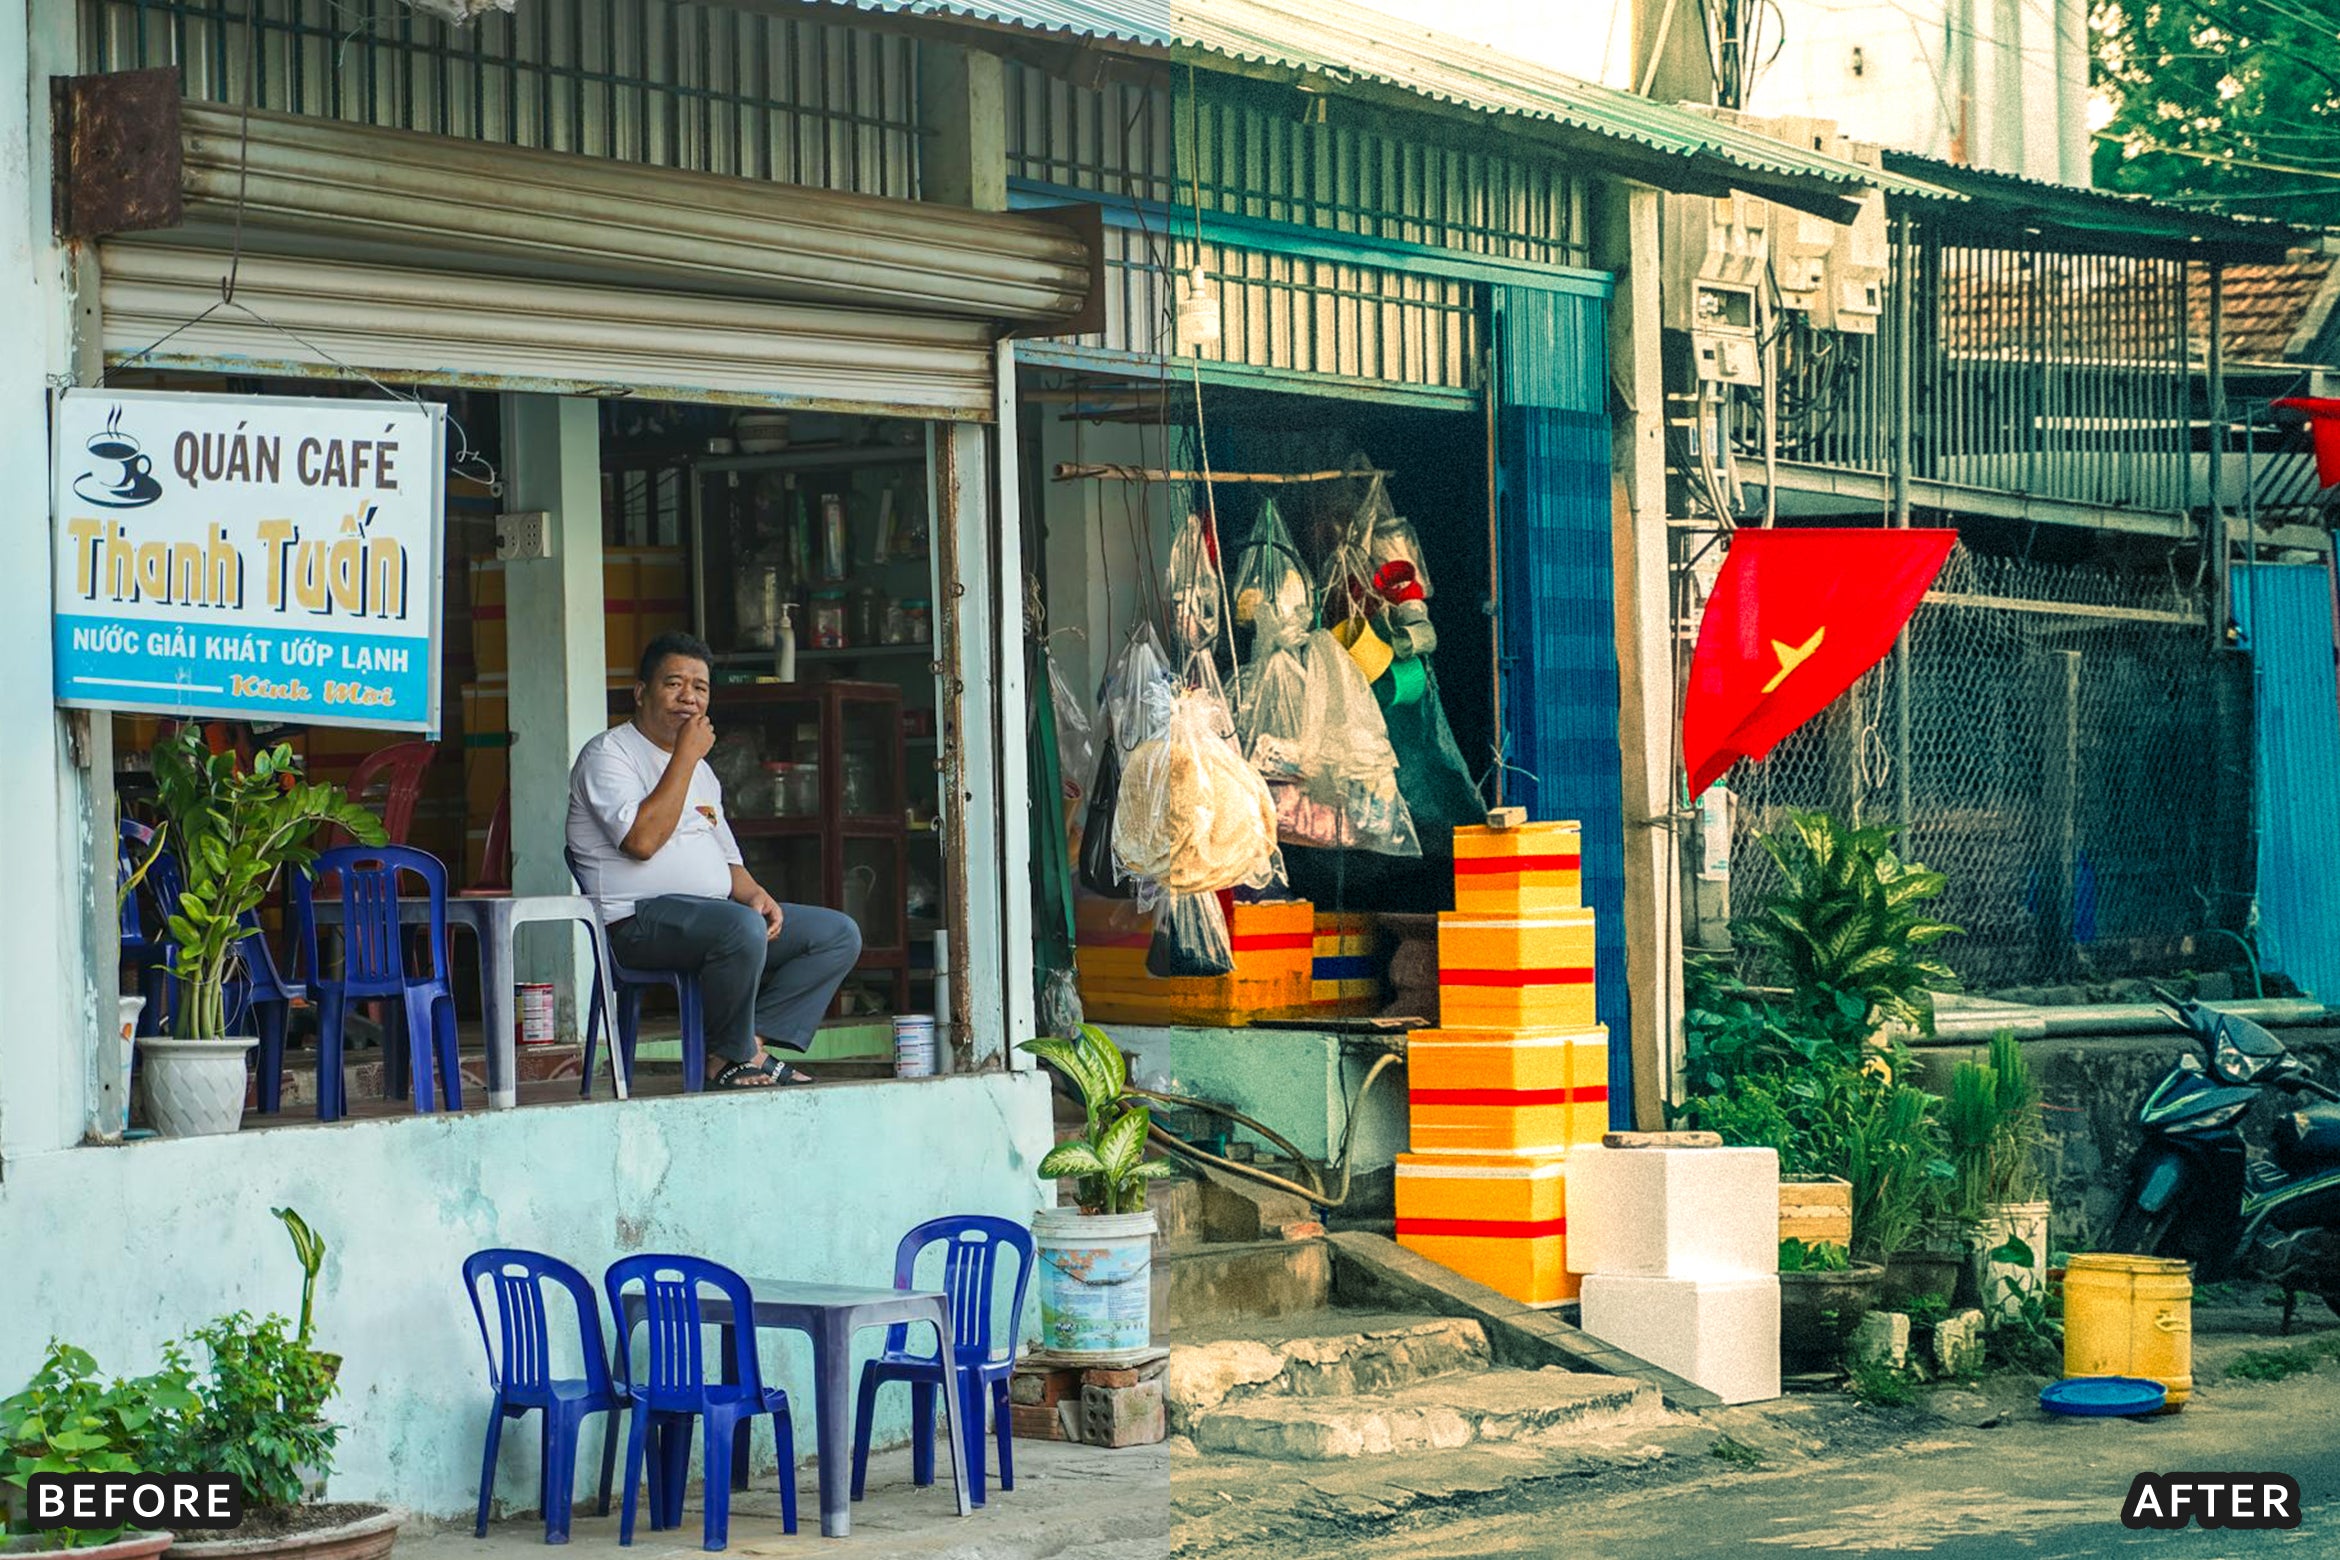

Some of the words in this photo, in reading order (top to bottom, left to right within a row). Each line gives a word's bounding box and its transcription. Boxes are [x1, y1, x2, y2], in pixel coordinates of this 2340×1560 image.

[174, 421, 280, 489] QUÁN
[297, 423, 399, 490] CAFÉ
[67, 517, 244, 610] Thanh
[257, 498, 408, 620] Tuấn
[73, 625, 139, 655] NƯỚC
[147, 626, 197, 658] GIẢI
[205, 633, 272, 663] KHÁT
[281, 636, 333, 667] ƯỚP
[341, 645, 409, 674] LẠNH
[229, 673, 312, 701] Kính
